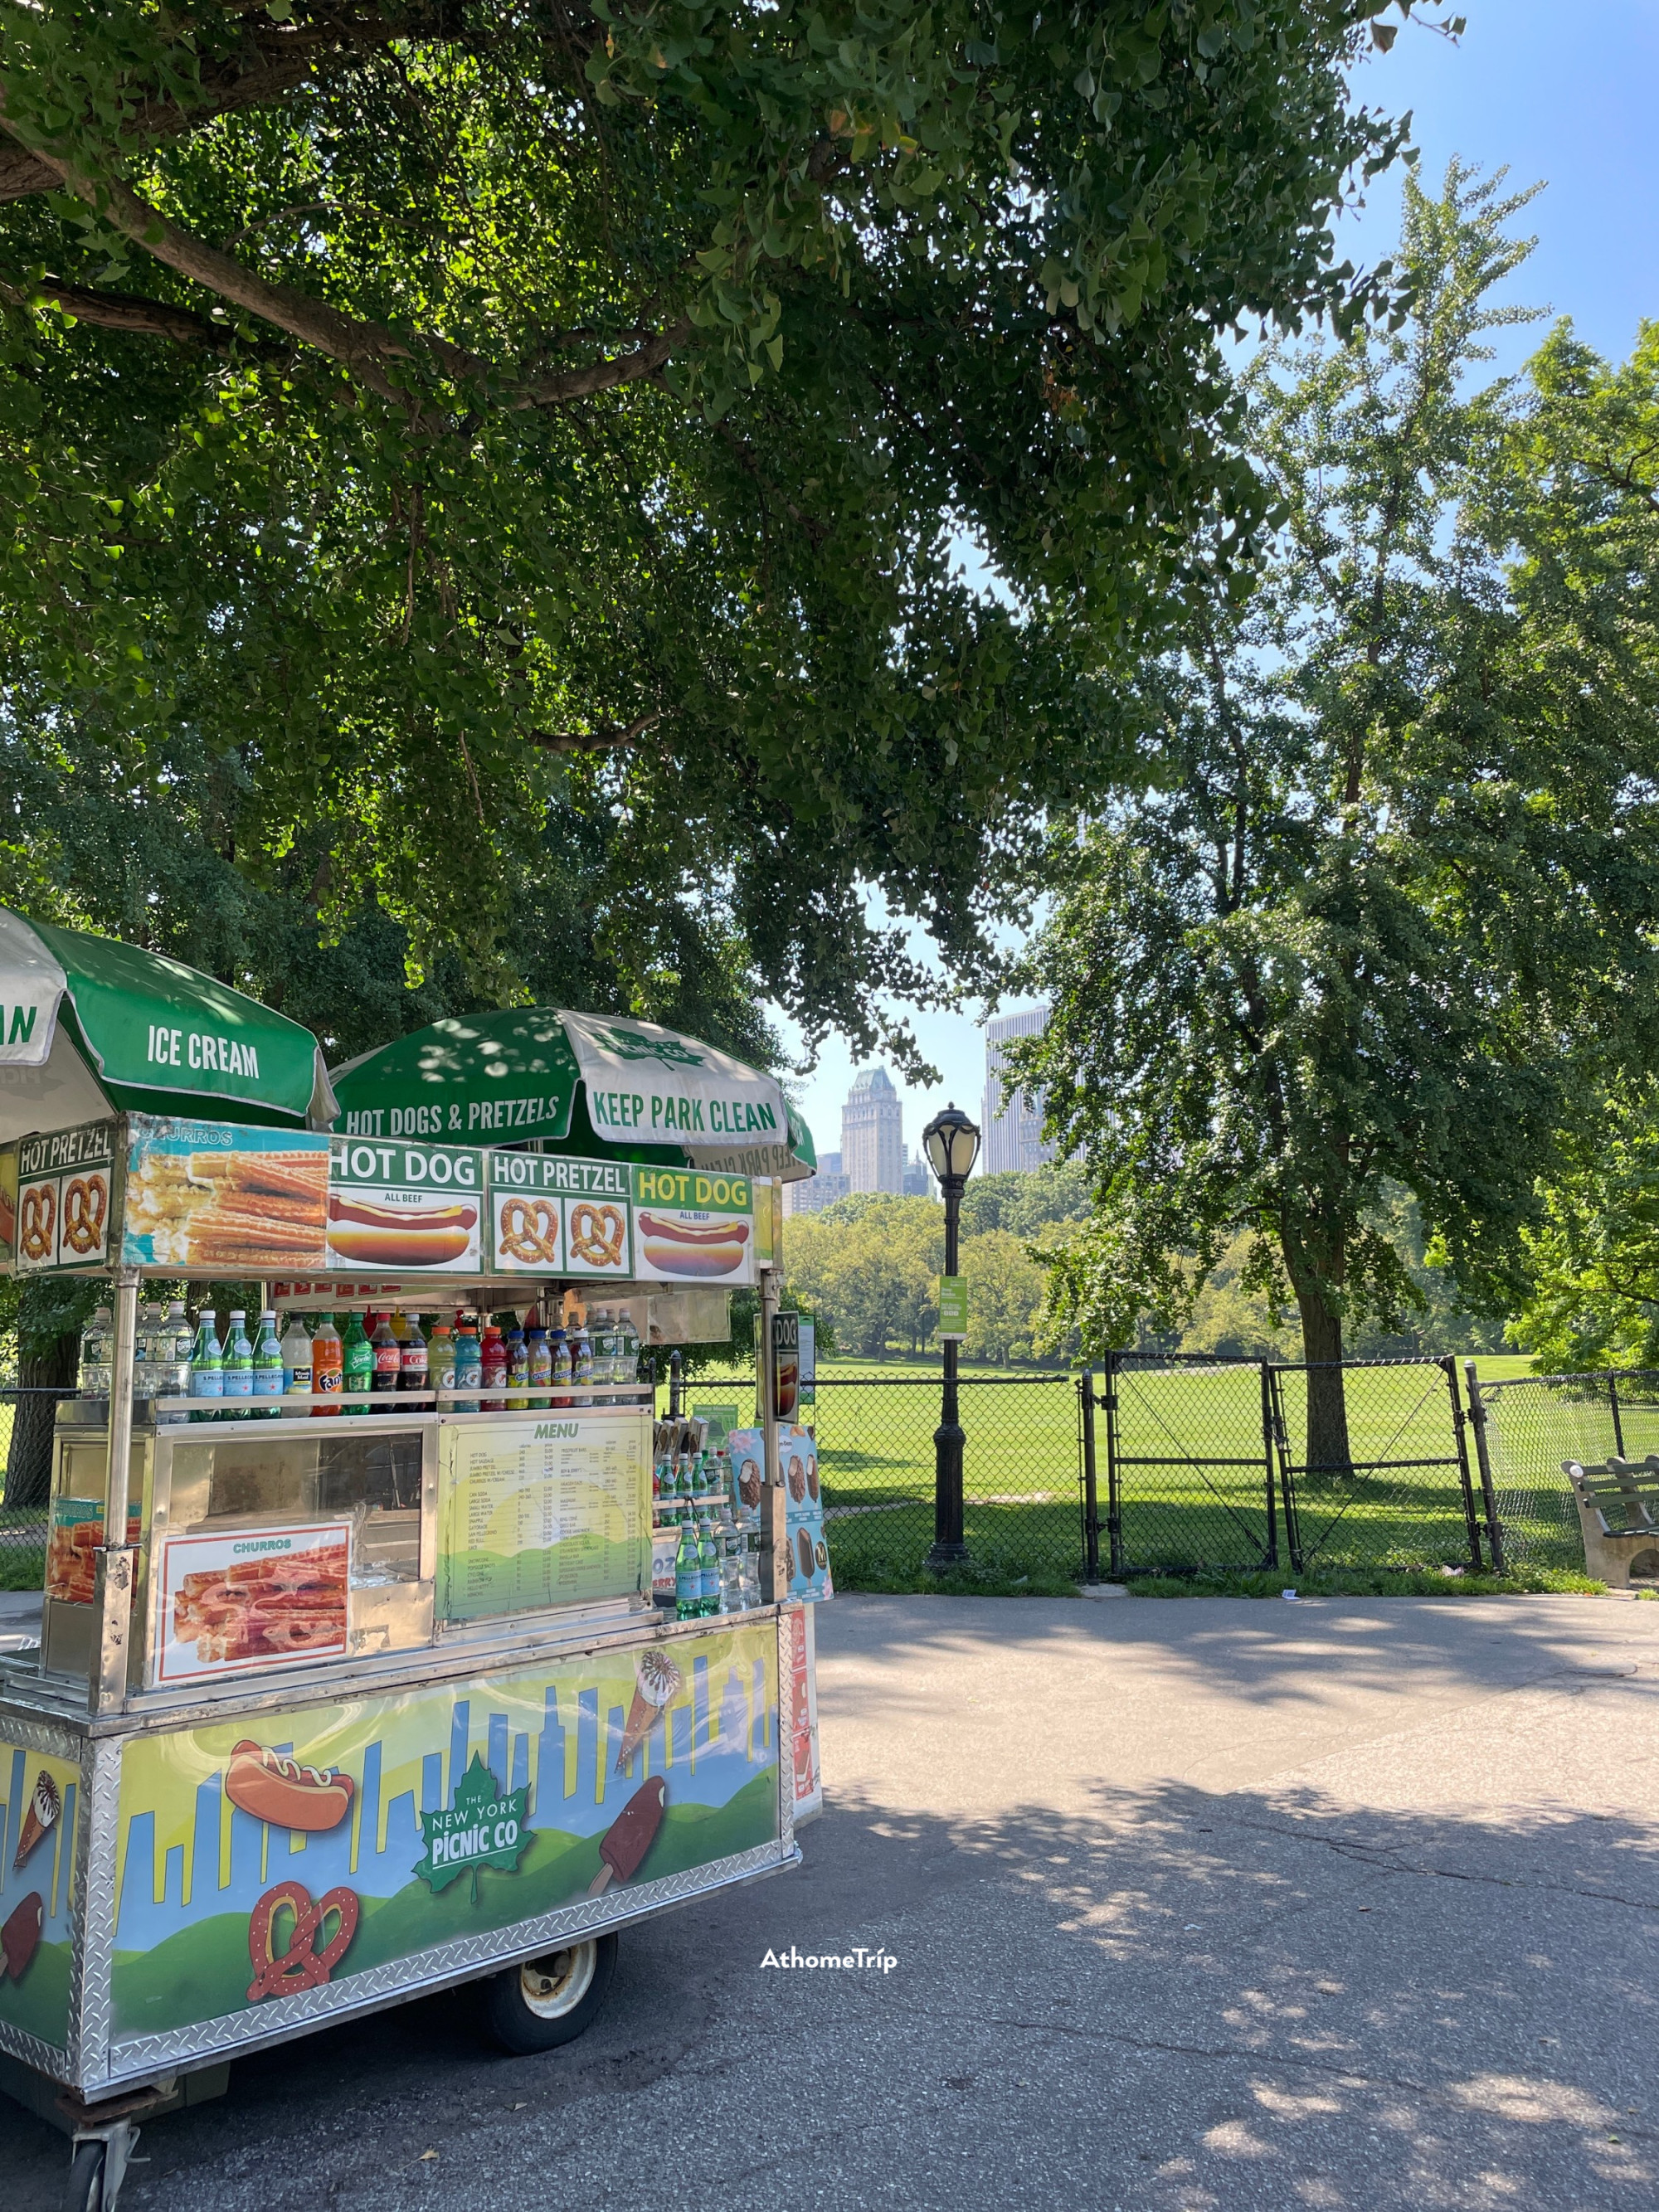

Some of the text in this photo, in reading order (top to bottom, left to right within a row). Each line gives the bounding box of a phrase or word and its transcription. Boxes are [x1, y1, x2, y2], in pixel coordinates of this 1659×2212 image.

[148, 1025, 260, 1079] ICE CREAM
[346, 1096, 560, 1137] HOT DOGS & PRETZELS
[592, 1091, 645, 1127] KEEP
[651, 1096, 705, 1132] PARK
[710, 1100, 778, 1132] CLEAN
[21, 1125, 111, 1174] HOT PRETZEL
[328, 1145, 476, 1186] HOT DOG
[494, 1155, 626, 1194] HOT PRETZEL
[639, 1173, 748, 1207] HOT DOG
[384, 1193, 423, 1203] ALL BEEF
[679, 1211, 710, 1221] ALL BEEF
[534, 1423, 579, 1439] MENU
[233, 1539, 292, 1554] CHURROS
[432, 1798, 518, 1831] NEW YORK
[466, 1795, 482, 1806] THE
[494, 1819, 518, 1848] CO
